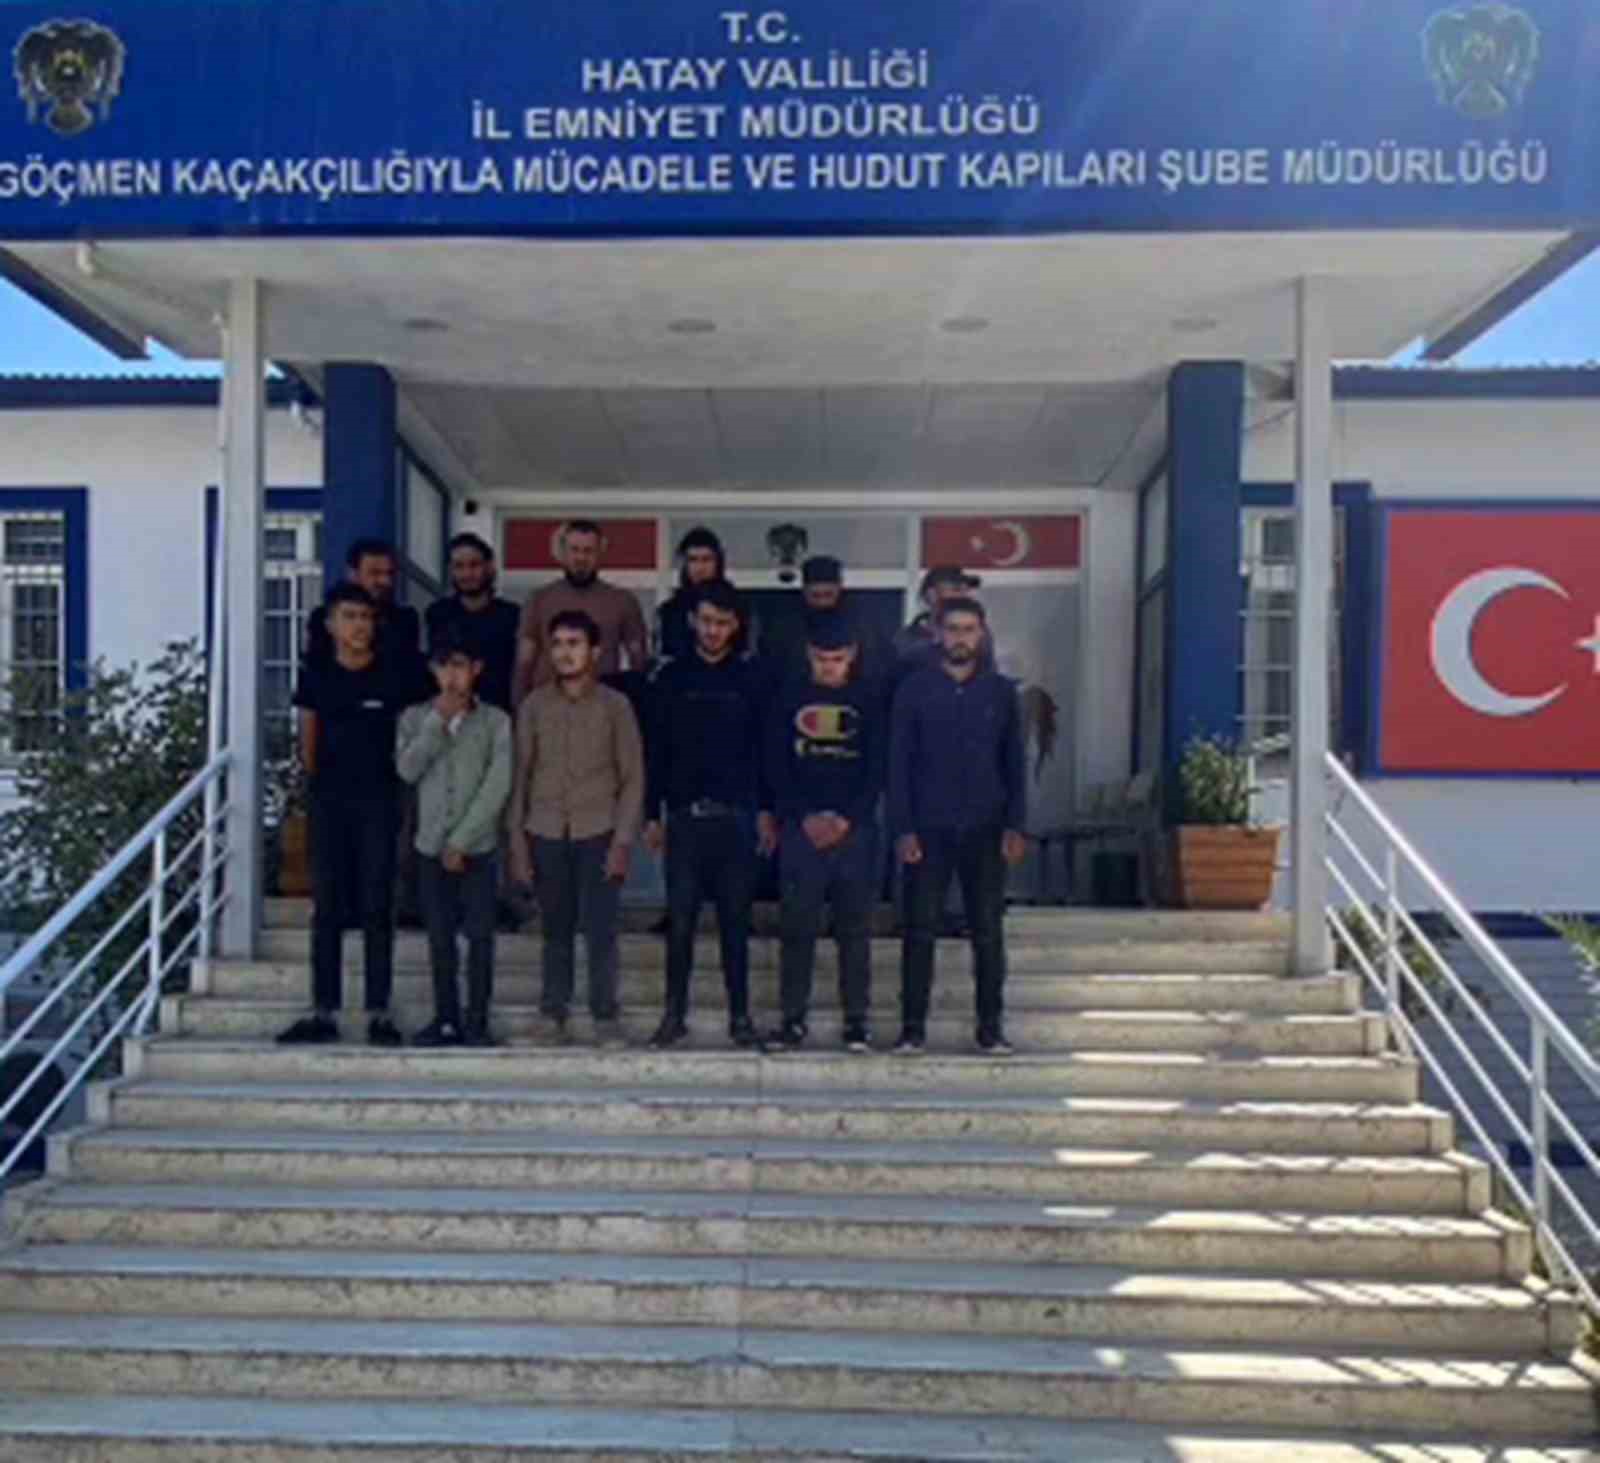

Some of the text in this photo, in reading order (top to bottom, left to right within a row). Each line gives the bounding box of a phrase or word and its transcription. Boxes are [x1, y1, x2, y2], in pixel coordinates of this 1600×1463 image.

[721, 11, 801, 44] T.C.
[581, 48, 930, 91] HATAY VALİLİĞİ
[472, 94, 1040, 139] İL EMNİYET MÜDÜRLÜĞÜ
[0, 141, 1549, 204] GÖÇMEN KAÇAKÇILIĞIYLA MÜCADELE VE HUDUT KAPILARI ŞUBE MÜDÜRLÜĞÜ
